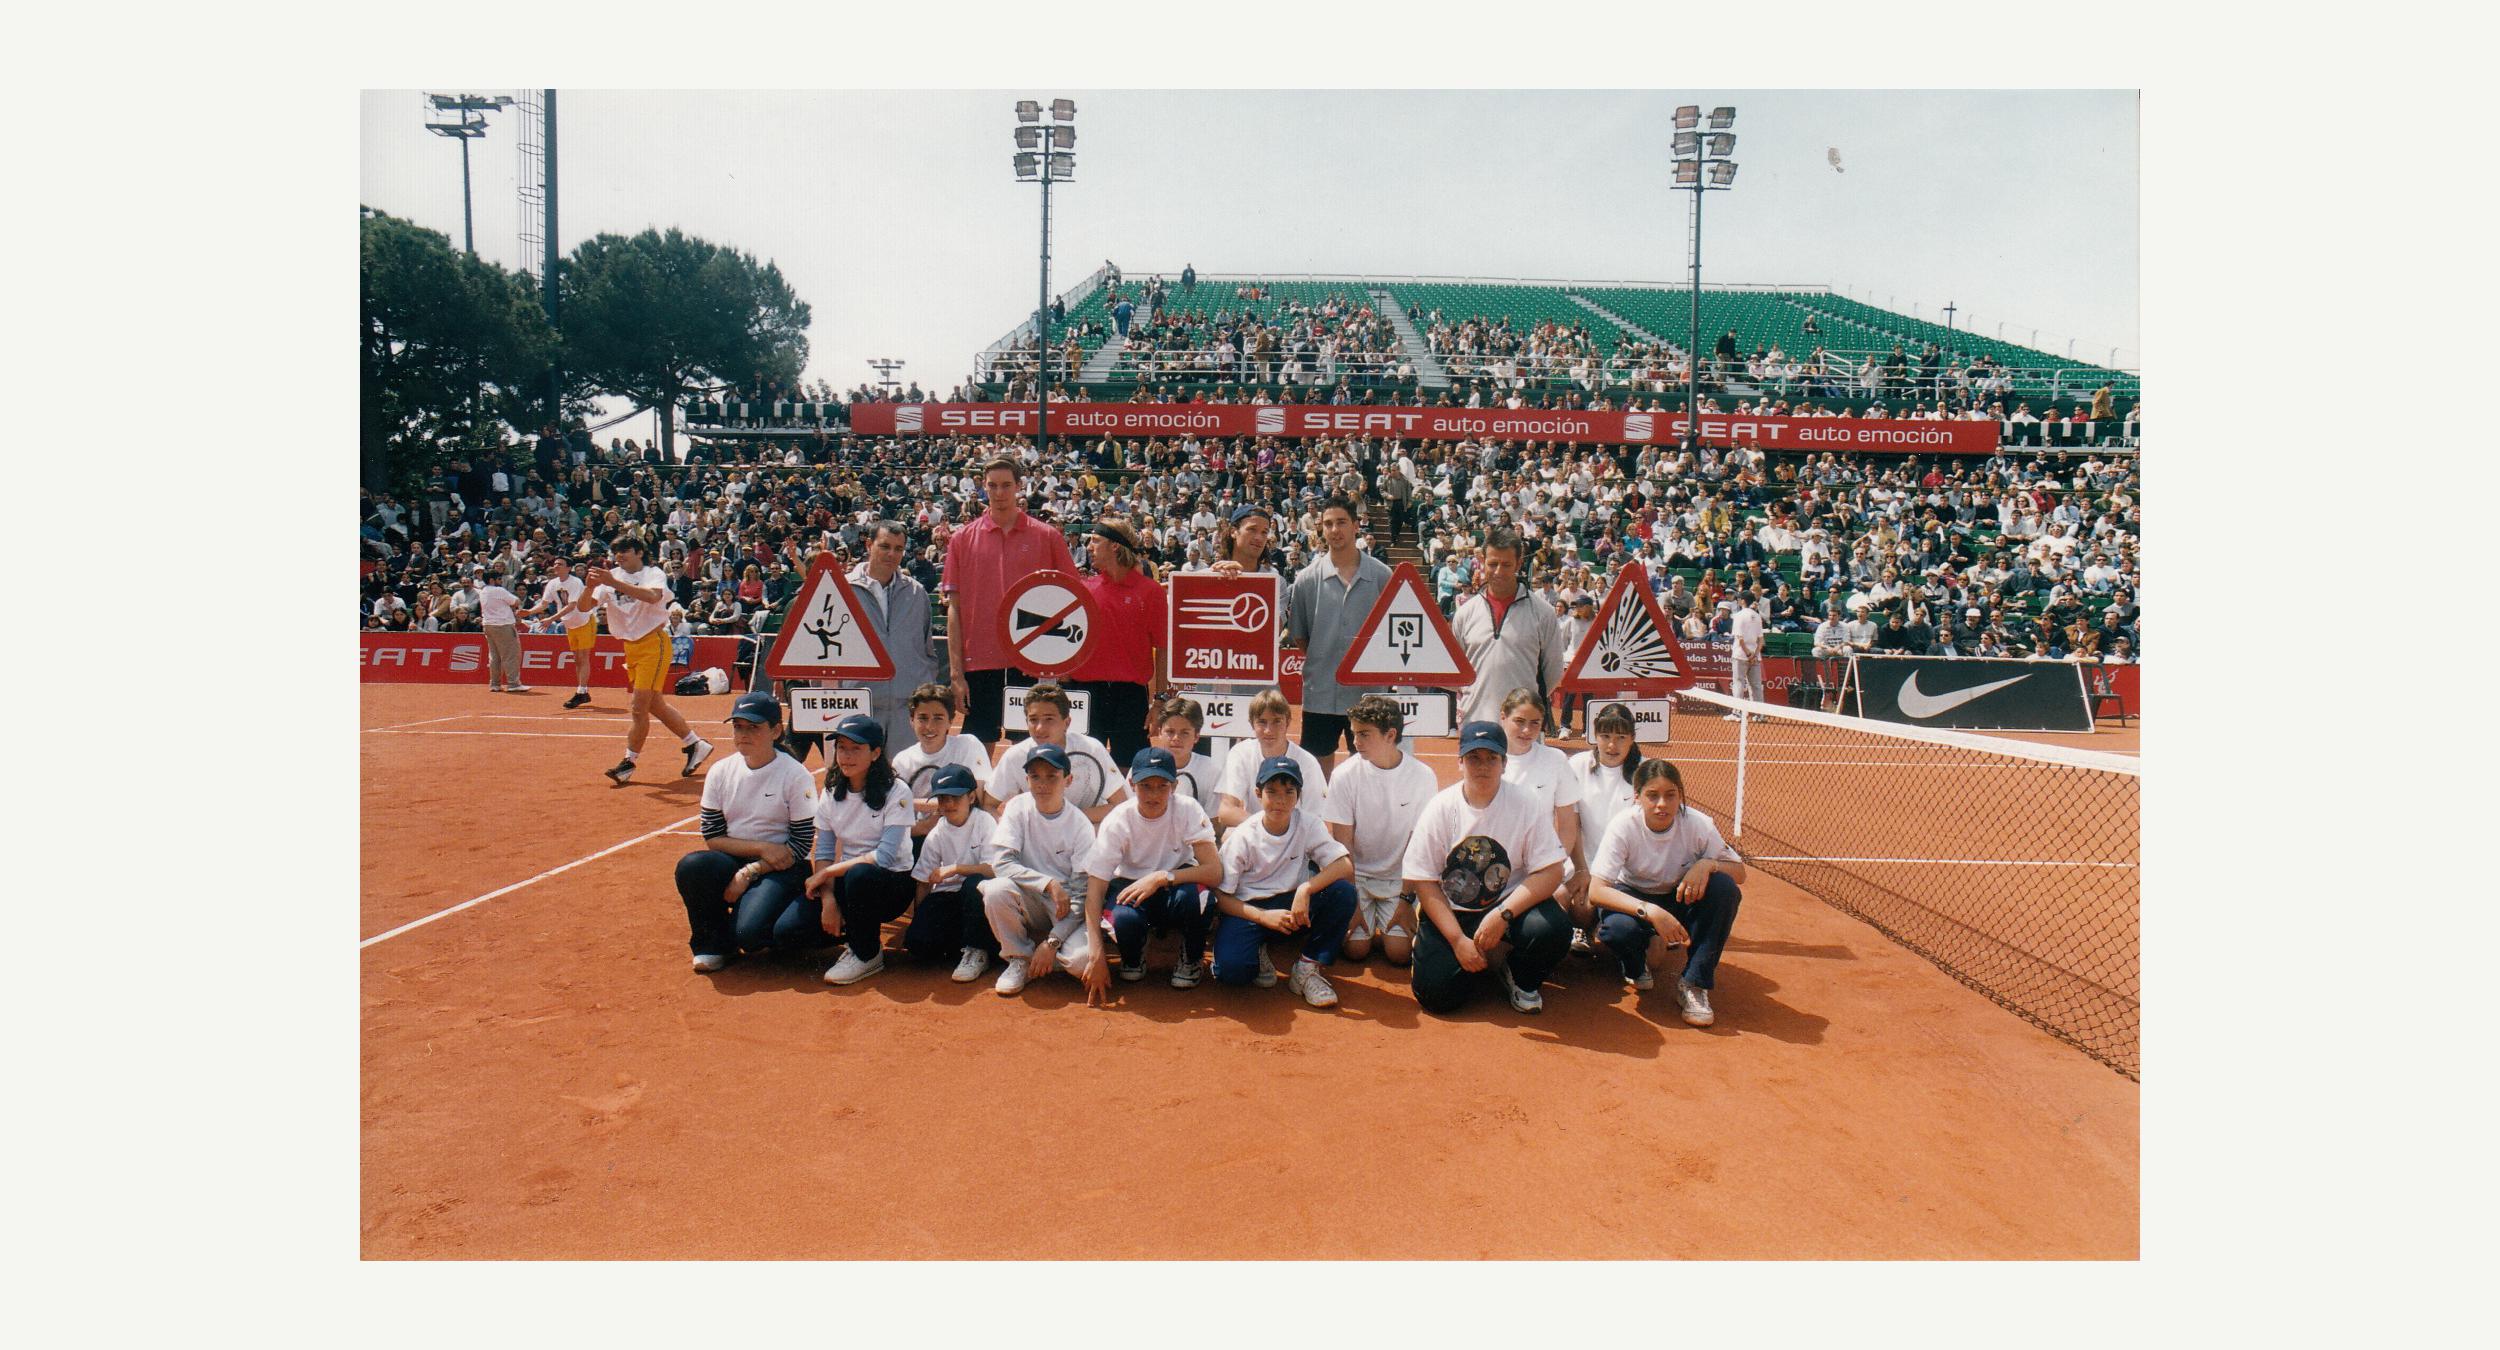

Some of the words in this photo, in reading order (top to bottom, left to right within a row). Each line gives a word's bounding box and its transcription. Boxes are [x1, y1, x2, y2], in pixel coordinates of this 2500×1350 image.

[1066, 411, 1118, 426] auto
[1125, 411, 1221, 428] emoción
[1303, 412, 1423, 430] SEAT
[1433, 417, 1486, 433] auto
[1492, 417, 1590, 435] emoción
[1671, 420, 1789, 440] SEAT
[1798, 426, 1851, 442] auto
[1857, 425, 1954, 444] emoción
[360, 647, 444, 666] AT
[520, 650, 626, 670] EAT
[1185, 648, 1223, 669] 250
[1227, 648, 1265, 670] km.
[801, 698, 818, 709] TIE
[821, 697, 859, 710] BREAK
[1009, 696, 1025, 707] SIL
[1206, 703, 1234, 716] ACE
[1401, 702, 1419, 716] UT
[1635, 711, 1662, 723] BALL
